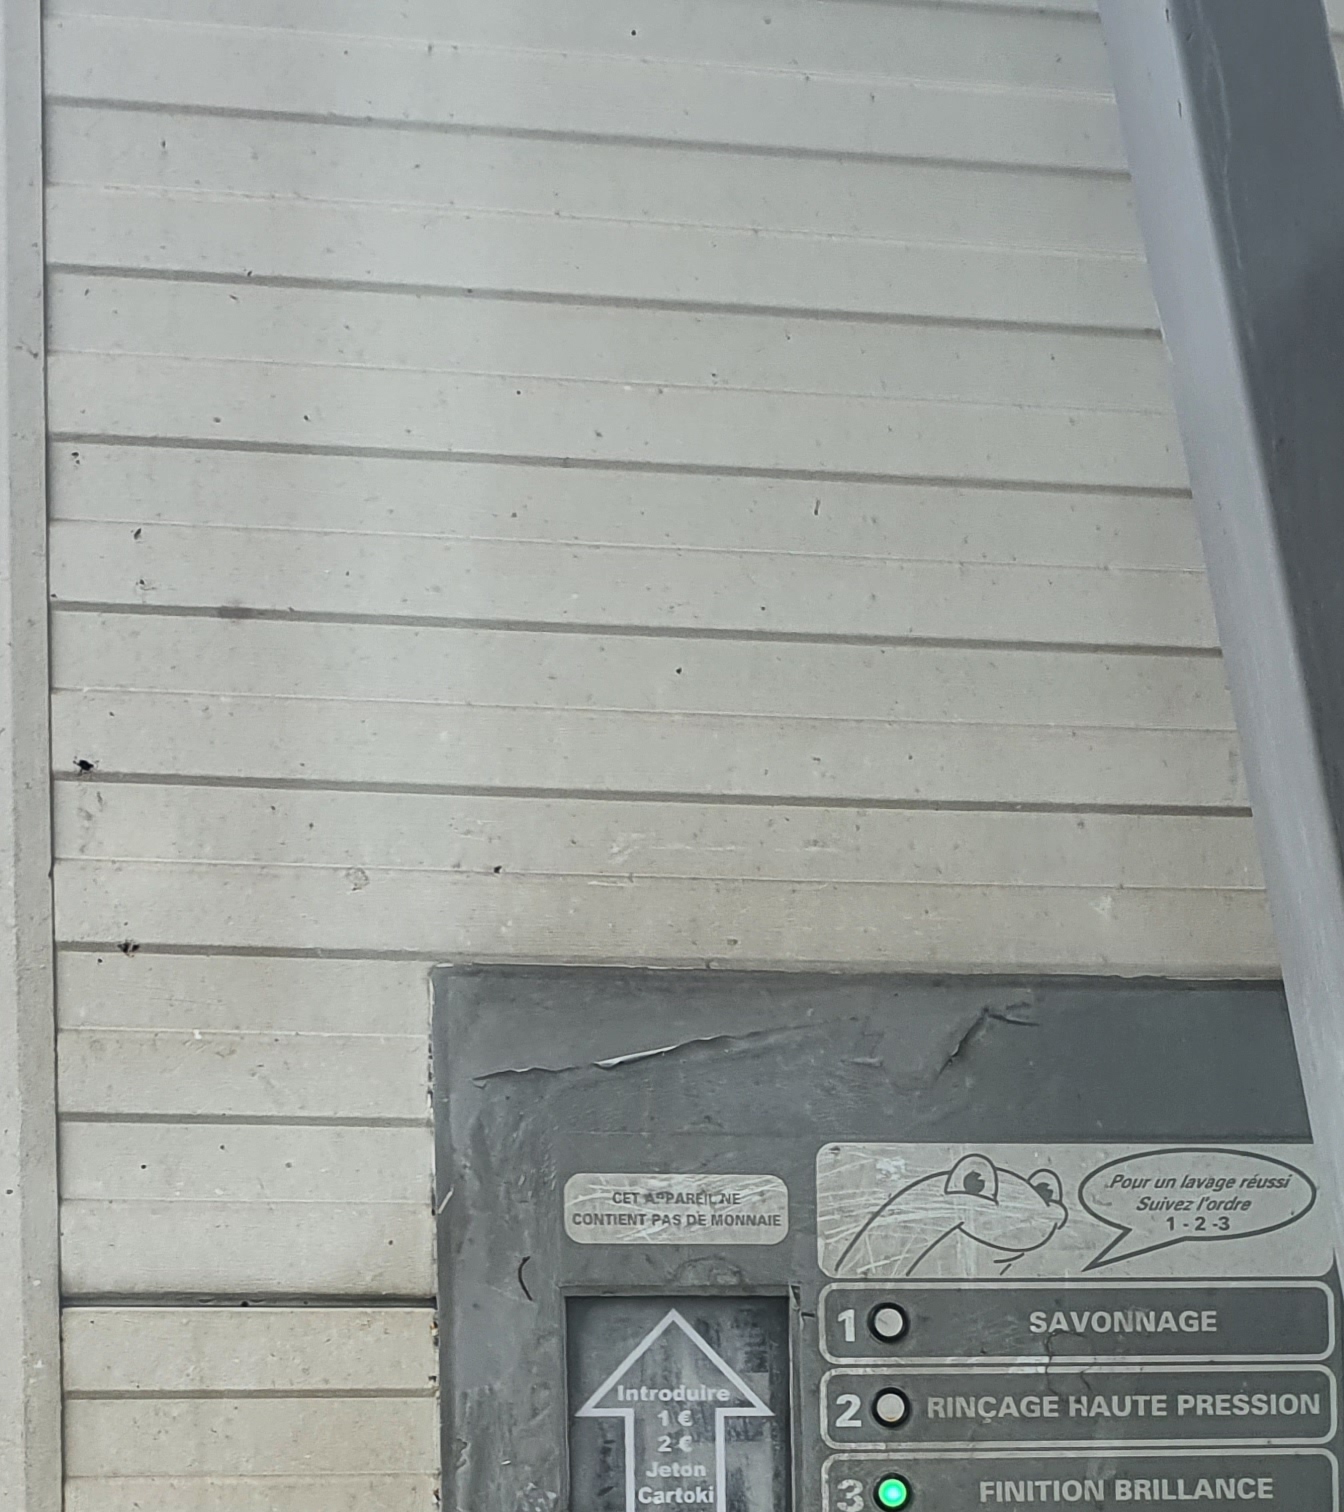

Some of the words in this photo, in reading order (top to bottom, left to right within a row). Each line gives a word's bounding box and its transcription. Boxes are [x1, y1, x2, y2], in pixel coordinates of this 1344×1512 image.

[1109, 1173, 1151, 1190] Pour
[1154, 1178, 1177, 1189] un
[1180, 1174, 1236, 1192] lavage
[1239, 1173, 1293, 1189] réussi
[612, 1191, 640, 1205] CET
[644, 1190, 718, 1206] APPAREIL
[721, 1192, 742, 1205] NE
[1136, 1196, 1194, 1211] Suivez
[1196, 1196, 1252, 1211] l'ordre
[572, 1213, 647, 1226] CONTIENT
[652, 1213, 682, 1226] PAS
[686, 1213, 707, 1226] DE
[711, 1213, 782, 1227] MONNAIE
[1166, 1216, 1175, 1231] 1
[1195, 1216, 1206, 1231] 2
[836, 1308, 856, 1343] 1
[1029, 1310, 1218, 1334] SAVONNAGE
[617, 1384, 731, 1402] Introduire
[834, 1393, 863, 1428] 2
[927, 1396, 1059, 1423] RINÇAGE
[1068, 1394, 1167, 1417] HAUTE
[1177, 1393, 1321, 1416] PRESSION
[645, 1461, 706, 1478] Jeton
[638, 1486, 714, 1504] Cartoki
[836, 1479, 865, 1512] 3
[979, 1479, 1105, 1503] FINITION
[1115, 1477, 1275, 1502] BRILLANCE
